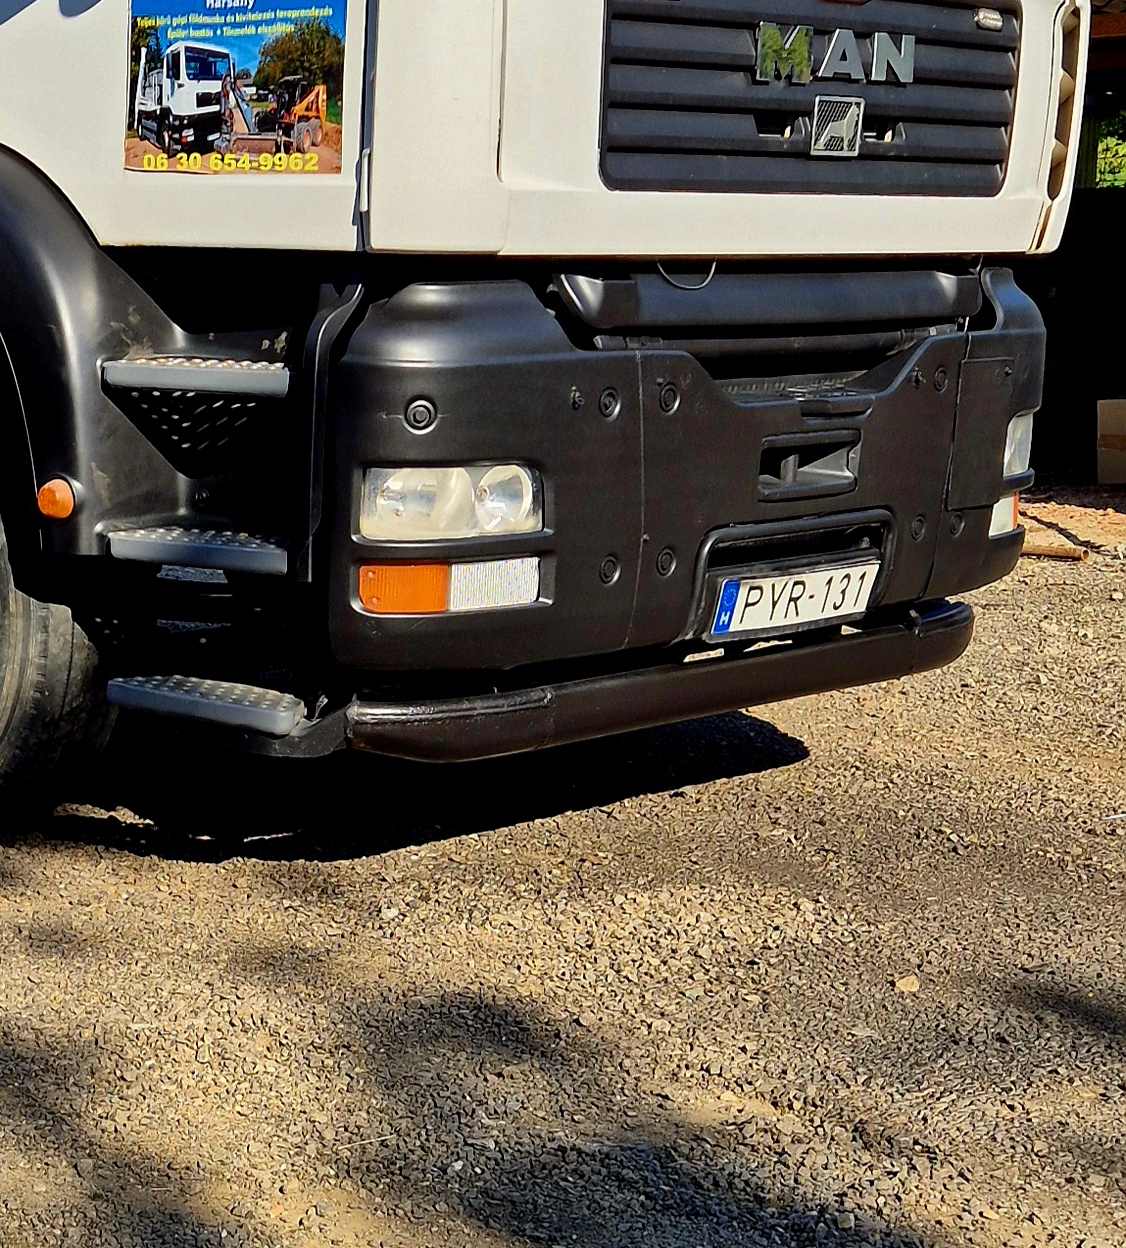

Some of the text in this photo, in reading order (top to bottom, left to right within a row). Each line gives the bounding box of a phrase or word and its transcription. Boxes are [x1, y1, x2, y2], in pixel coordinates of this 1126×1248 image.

[755, 21, 916, 85] MAN
[143, 152, 319, 172] 06 30 654-9962
[739, 570, 868, 624] PYR-131
[719, 613, 730, 626] H
